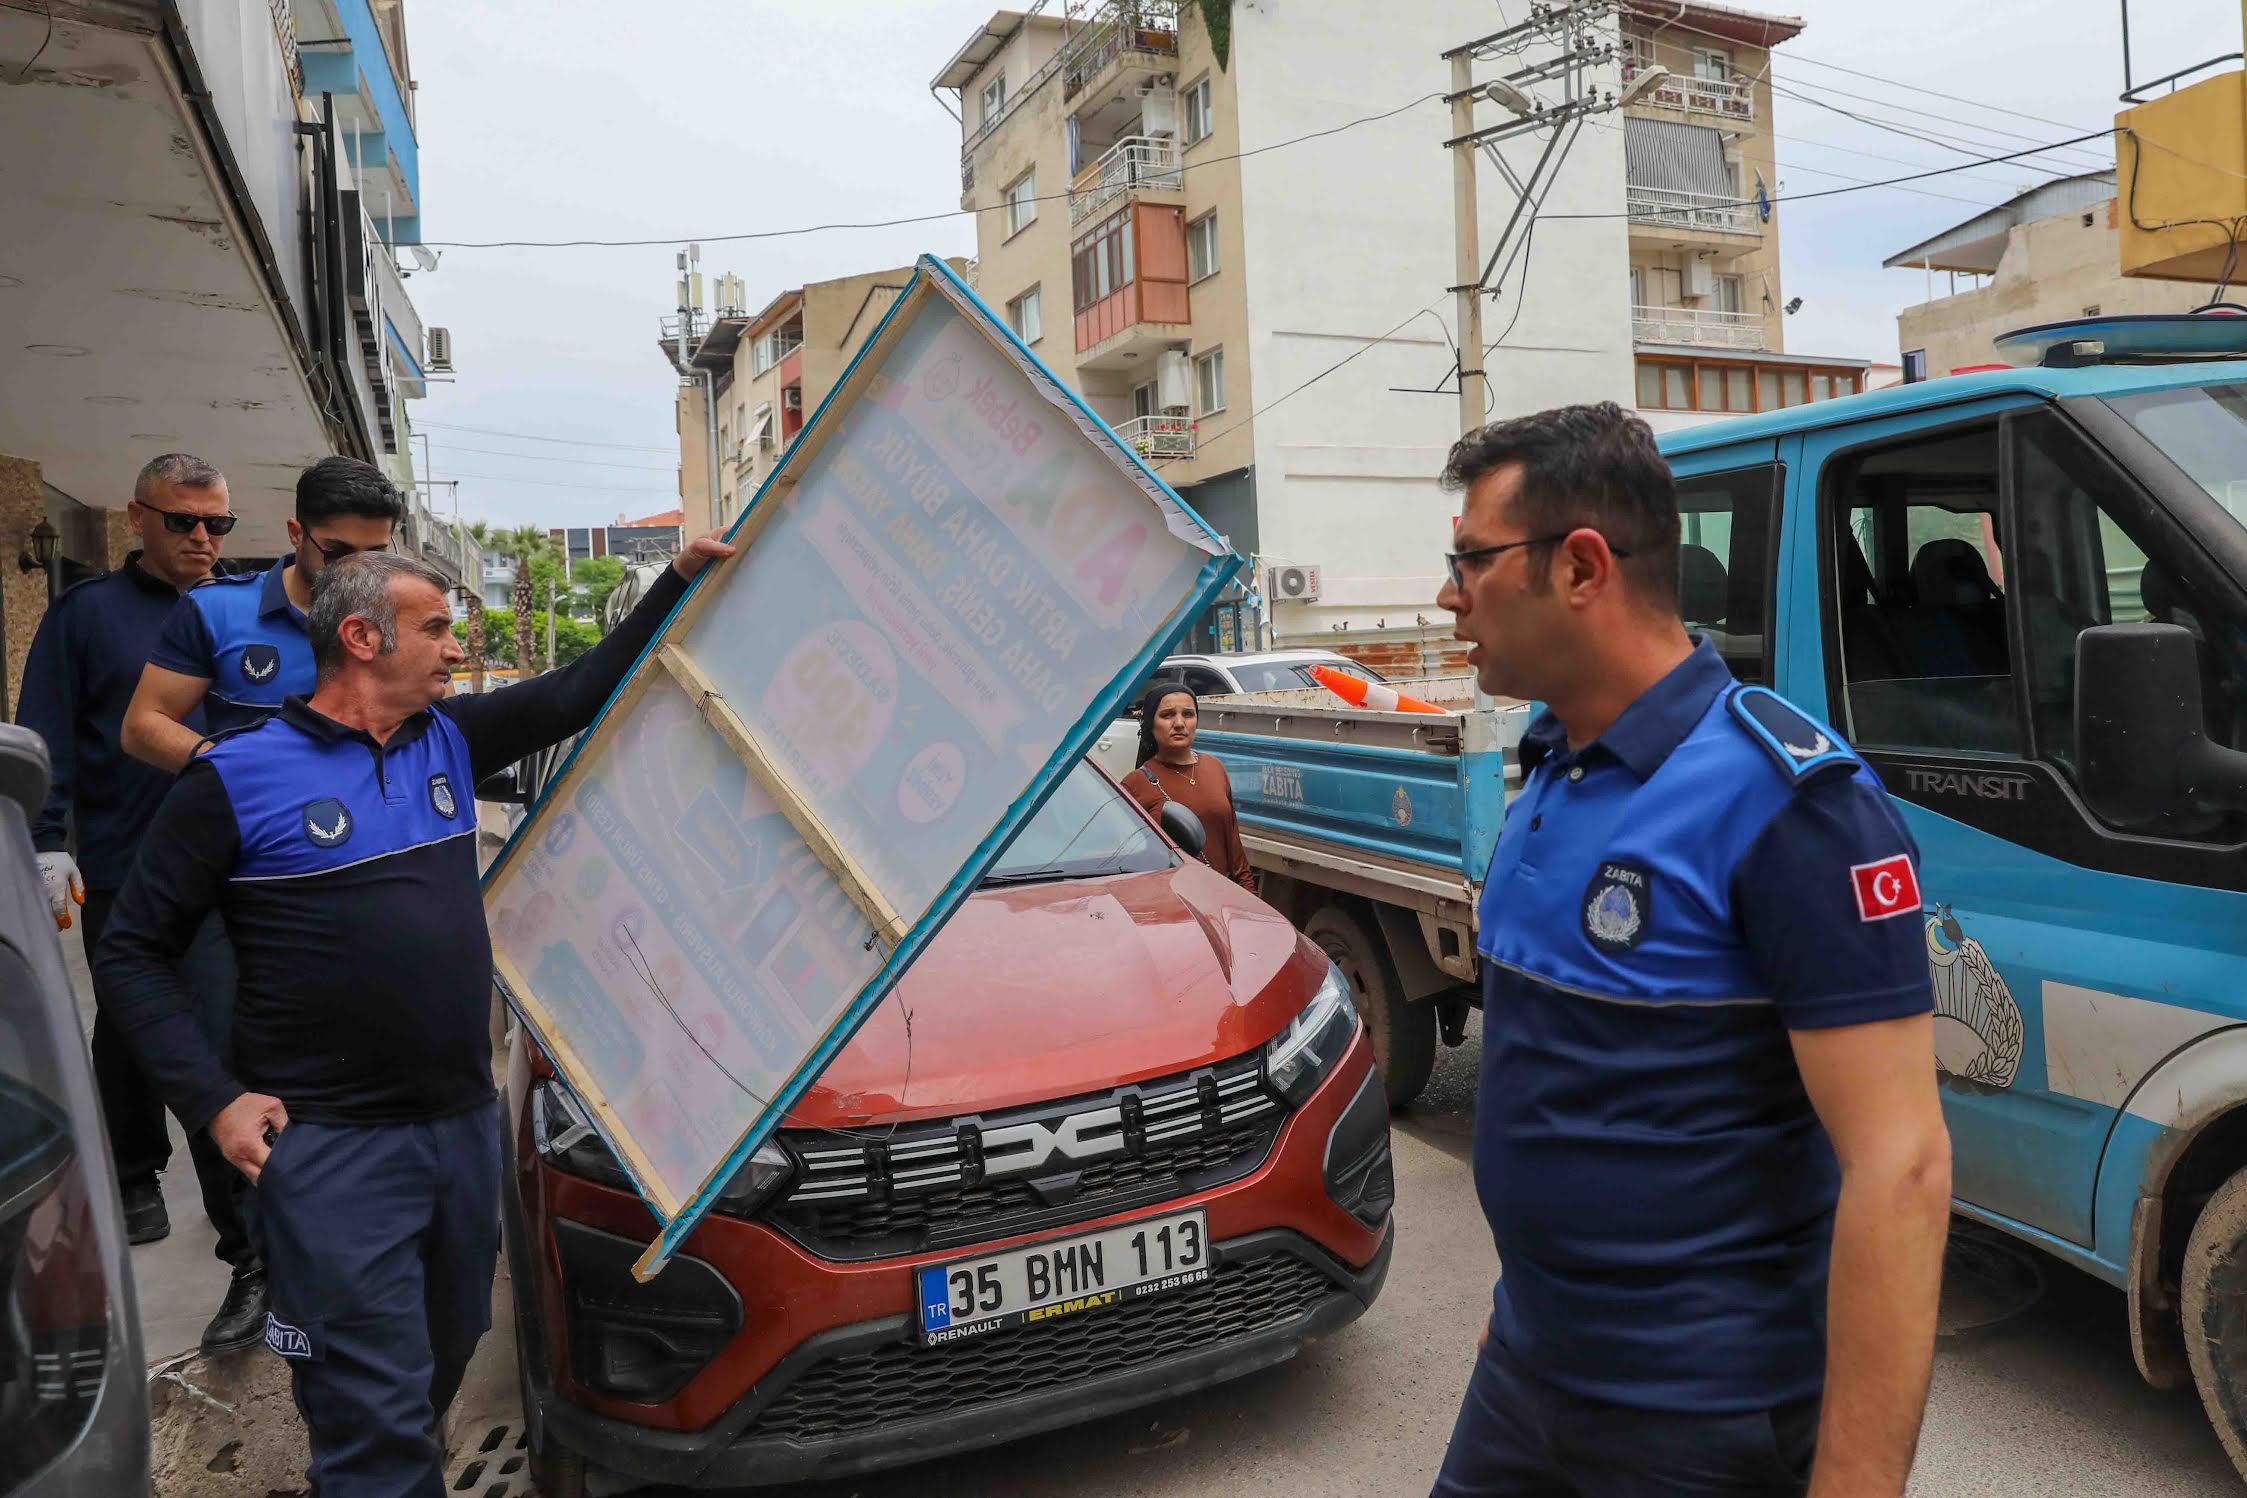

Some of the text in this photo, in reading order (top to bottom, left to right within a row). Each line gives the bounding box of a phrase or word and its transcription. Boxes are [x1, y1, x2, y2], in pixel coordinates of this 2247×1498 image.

[1263, 775, 1304, 801] ZABITA
[1906, 770, 2033, 801] TRANSIT
[1604, 865, 1643, 888] ZABITA
[949, 1220, 1201, 1318] 35 BMN 113
[1135, 1269, 1208, 1296] 0232 253 66 66
[928, 1302, 947, 1319] TR
[1028, 1291, 1116, 1322] ERMAT
[268, 1320, 307, 1351] ABITA
[937, 1318, 1003, 1343] RENAULT
